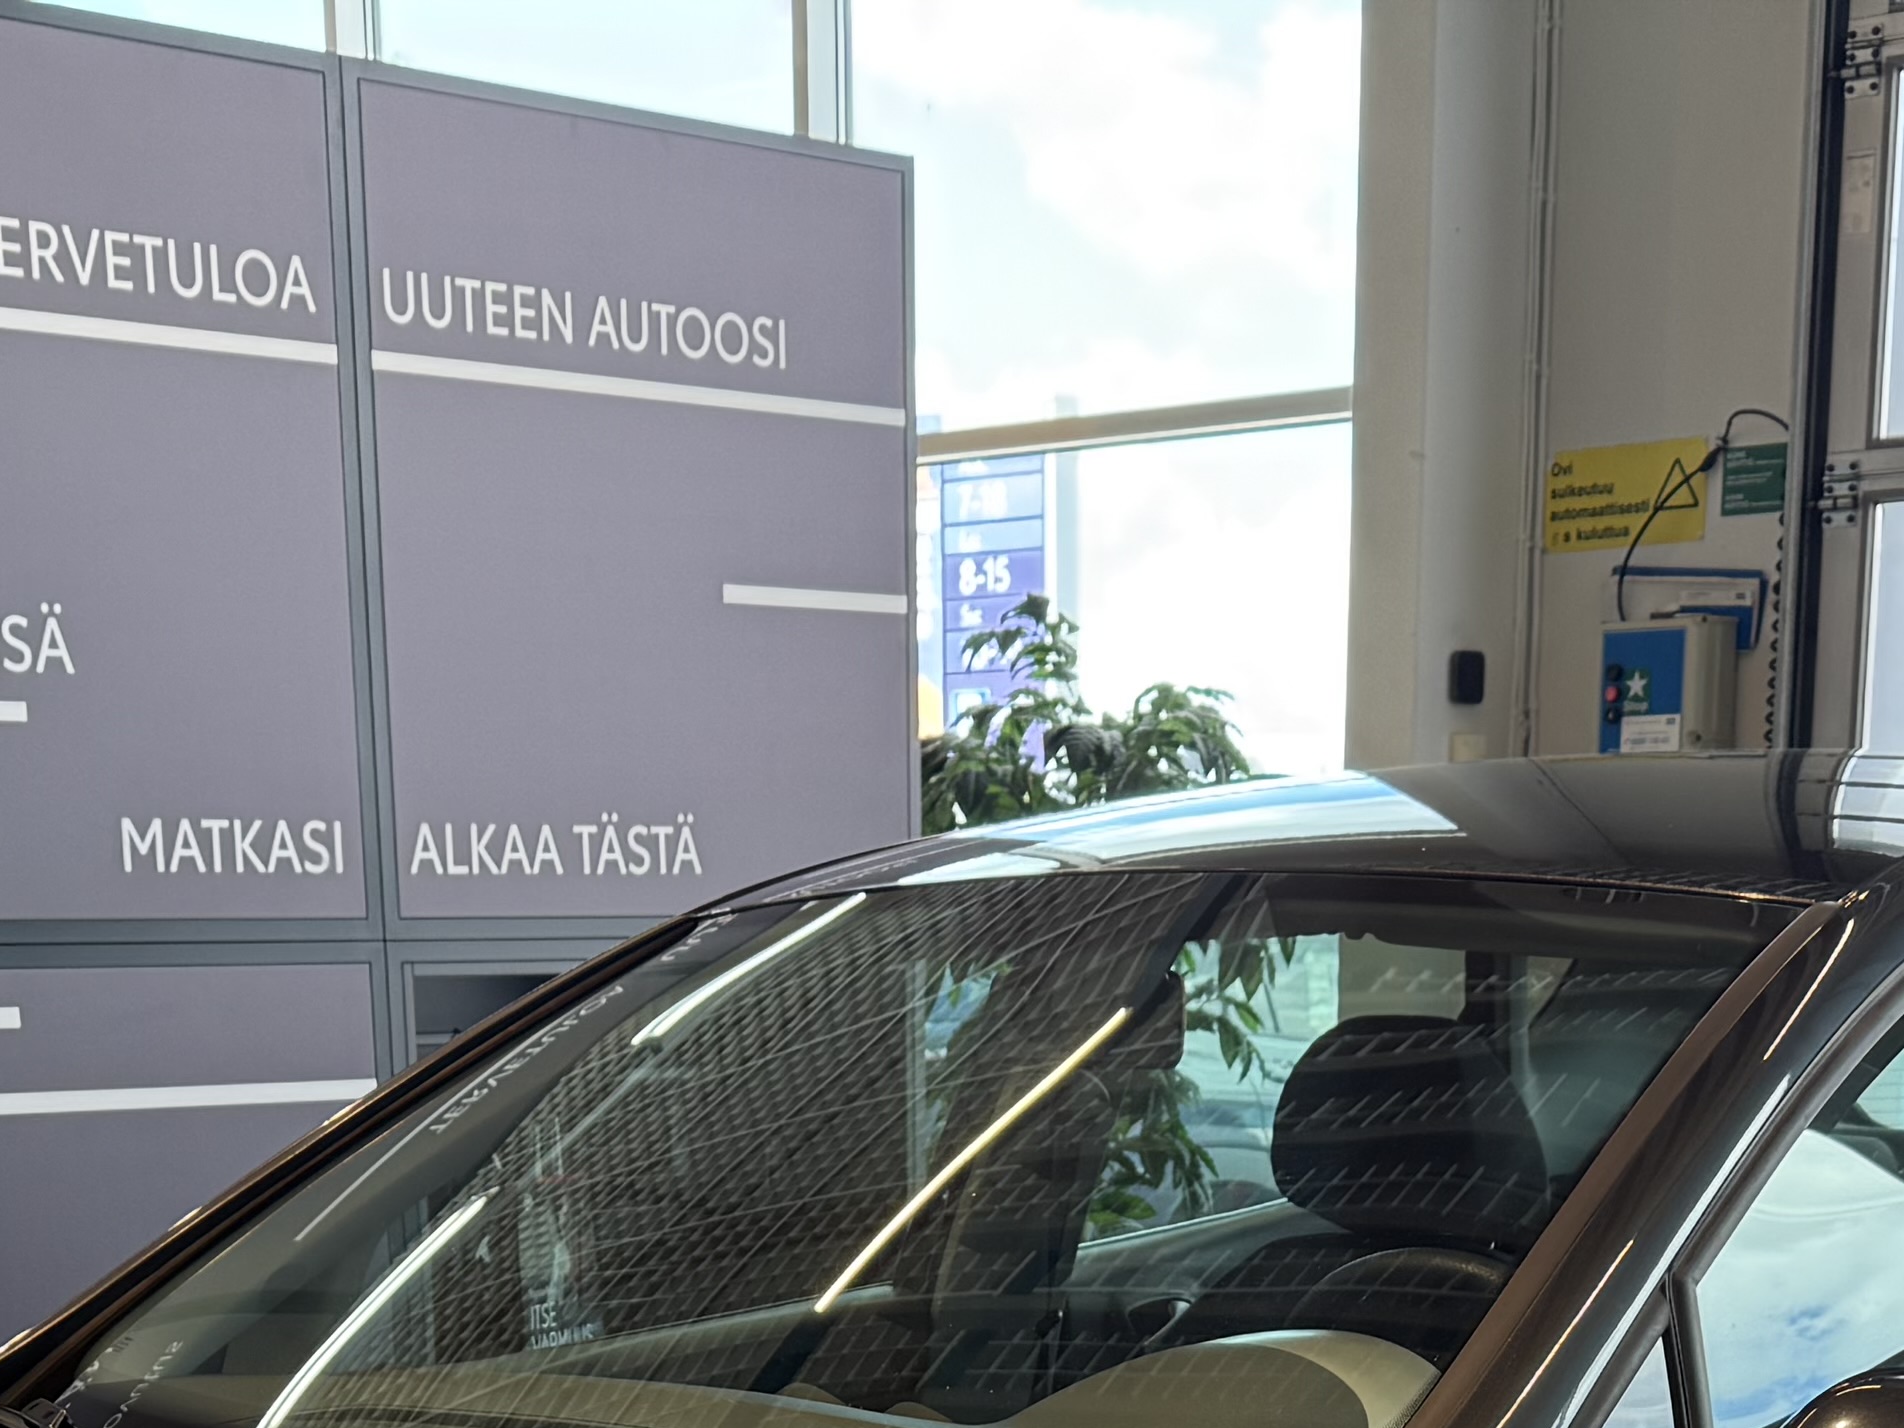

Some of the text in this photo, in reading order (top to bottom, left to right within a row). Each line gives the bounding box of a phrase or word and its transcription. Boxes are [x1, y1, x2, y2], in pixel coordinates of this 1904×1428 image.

[382, 267, 574, 345] UUTEEN
[588, 295, 786, 370] AUTOOSI
[1551, 462, 1573, 477] Ovi
[1551, 482, 1614, 500] sulkeutuu
[1550, 499, 1650, 521] automaattisesti
[958, 556, 1011, 597] 8-15
[120, 811, 702, 876] MATKASI ALKAA TÄSTÄ
[529, 1301, 558, 1331] ITSE
